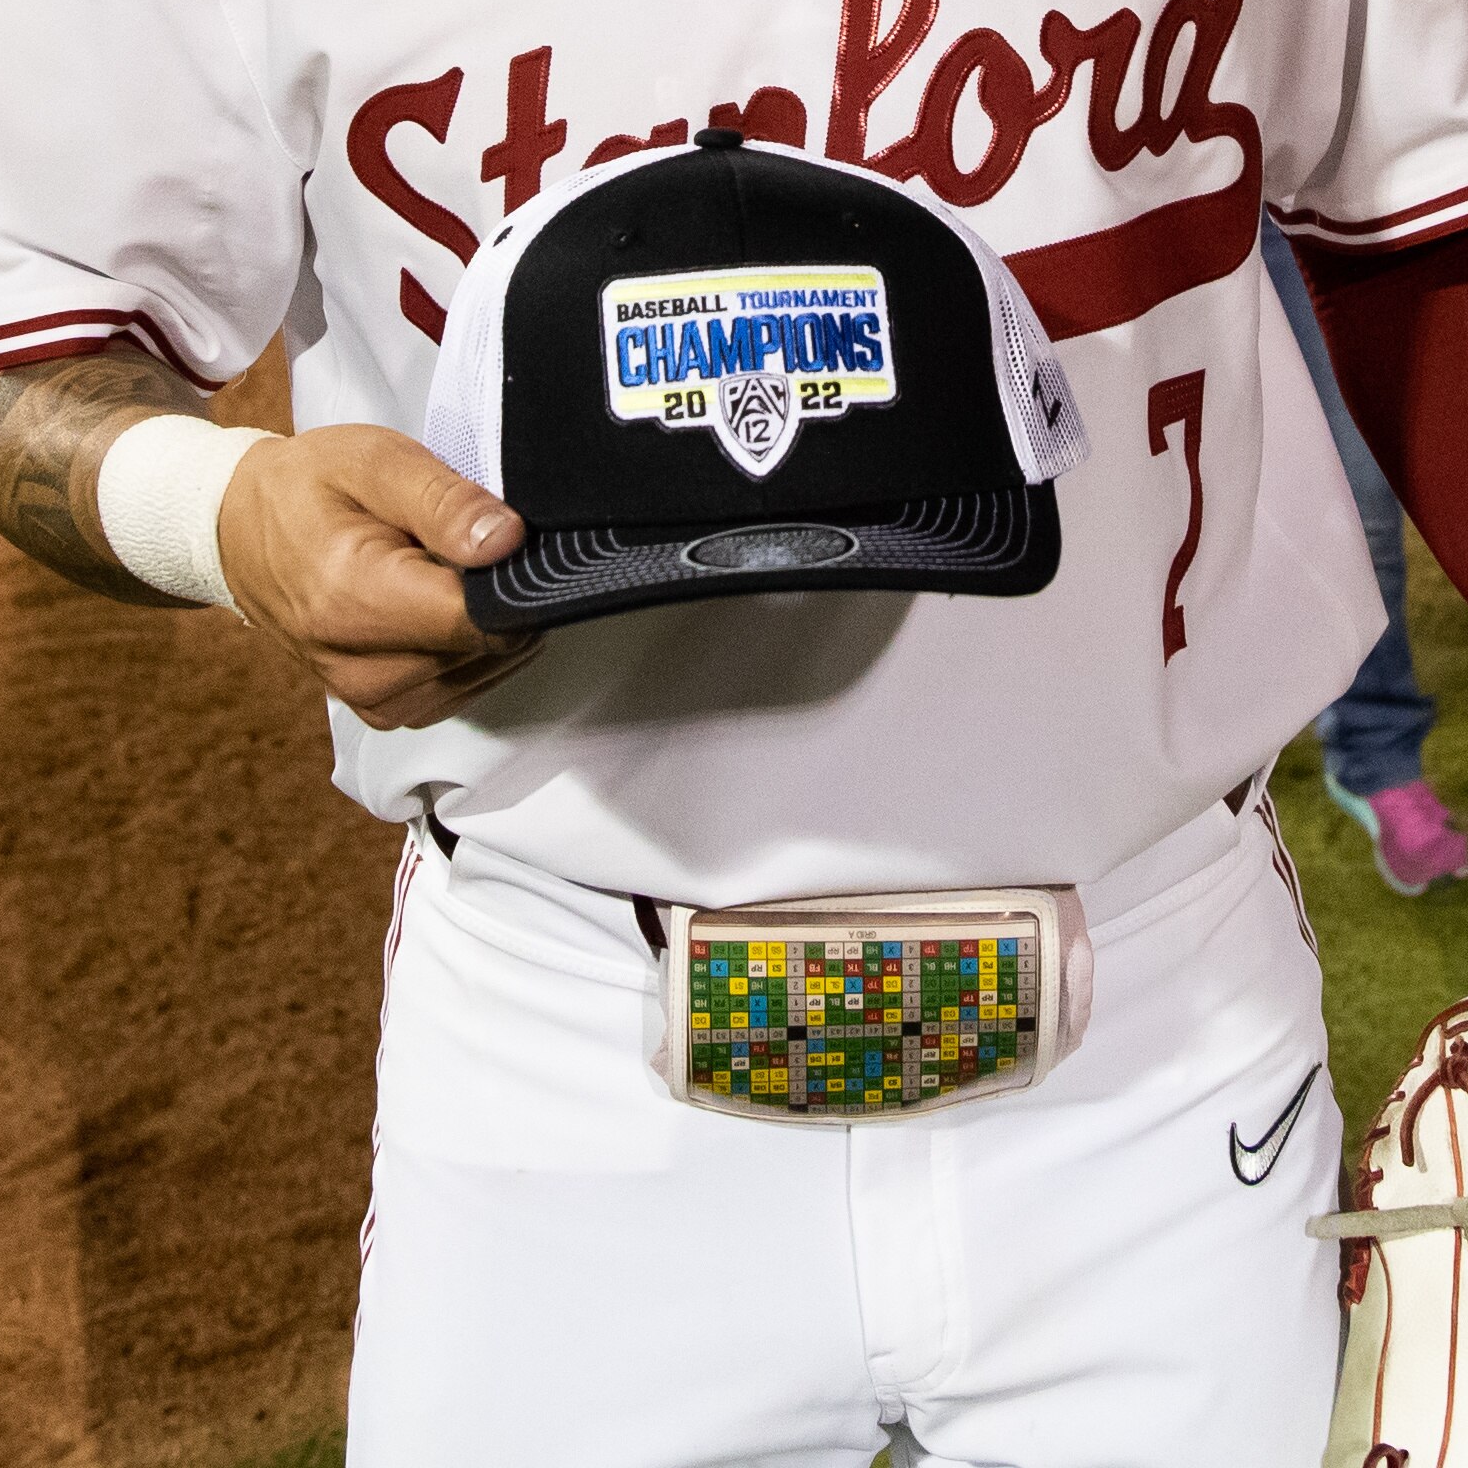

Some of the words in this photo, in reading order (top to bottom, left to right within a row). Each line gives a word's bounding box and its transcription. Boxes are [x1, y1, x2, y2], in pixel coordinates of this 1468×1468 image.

[617, 294, 727, 323] BASEBALL
[737, 289, 878, 311] TOURNAMENT
[616, 312, 884, 388] CHAMPIONS
[664, 390, 706, 421] 20
[800, 381, 842, 410] 22
[744, 419, 772, 443] 12
[1147, 368, 1206, 668] 7
[848, 931, 855, 939] A
[856, 931, 877, 939] GRID
[847, 947, 859, 955] RP
[924, 945, 935, 954] TP
[963, 945, 974, 953] TP
[848, 964, 859, 972] TK
[886, 964, 897, 972] TP
[910, 996, 913, 1004] 1
[982, 994, 993, 1002] RP
